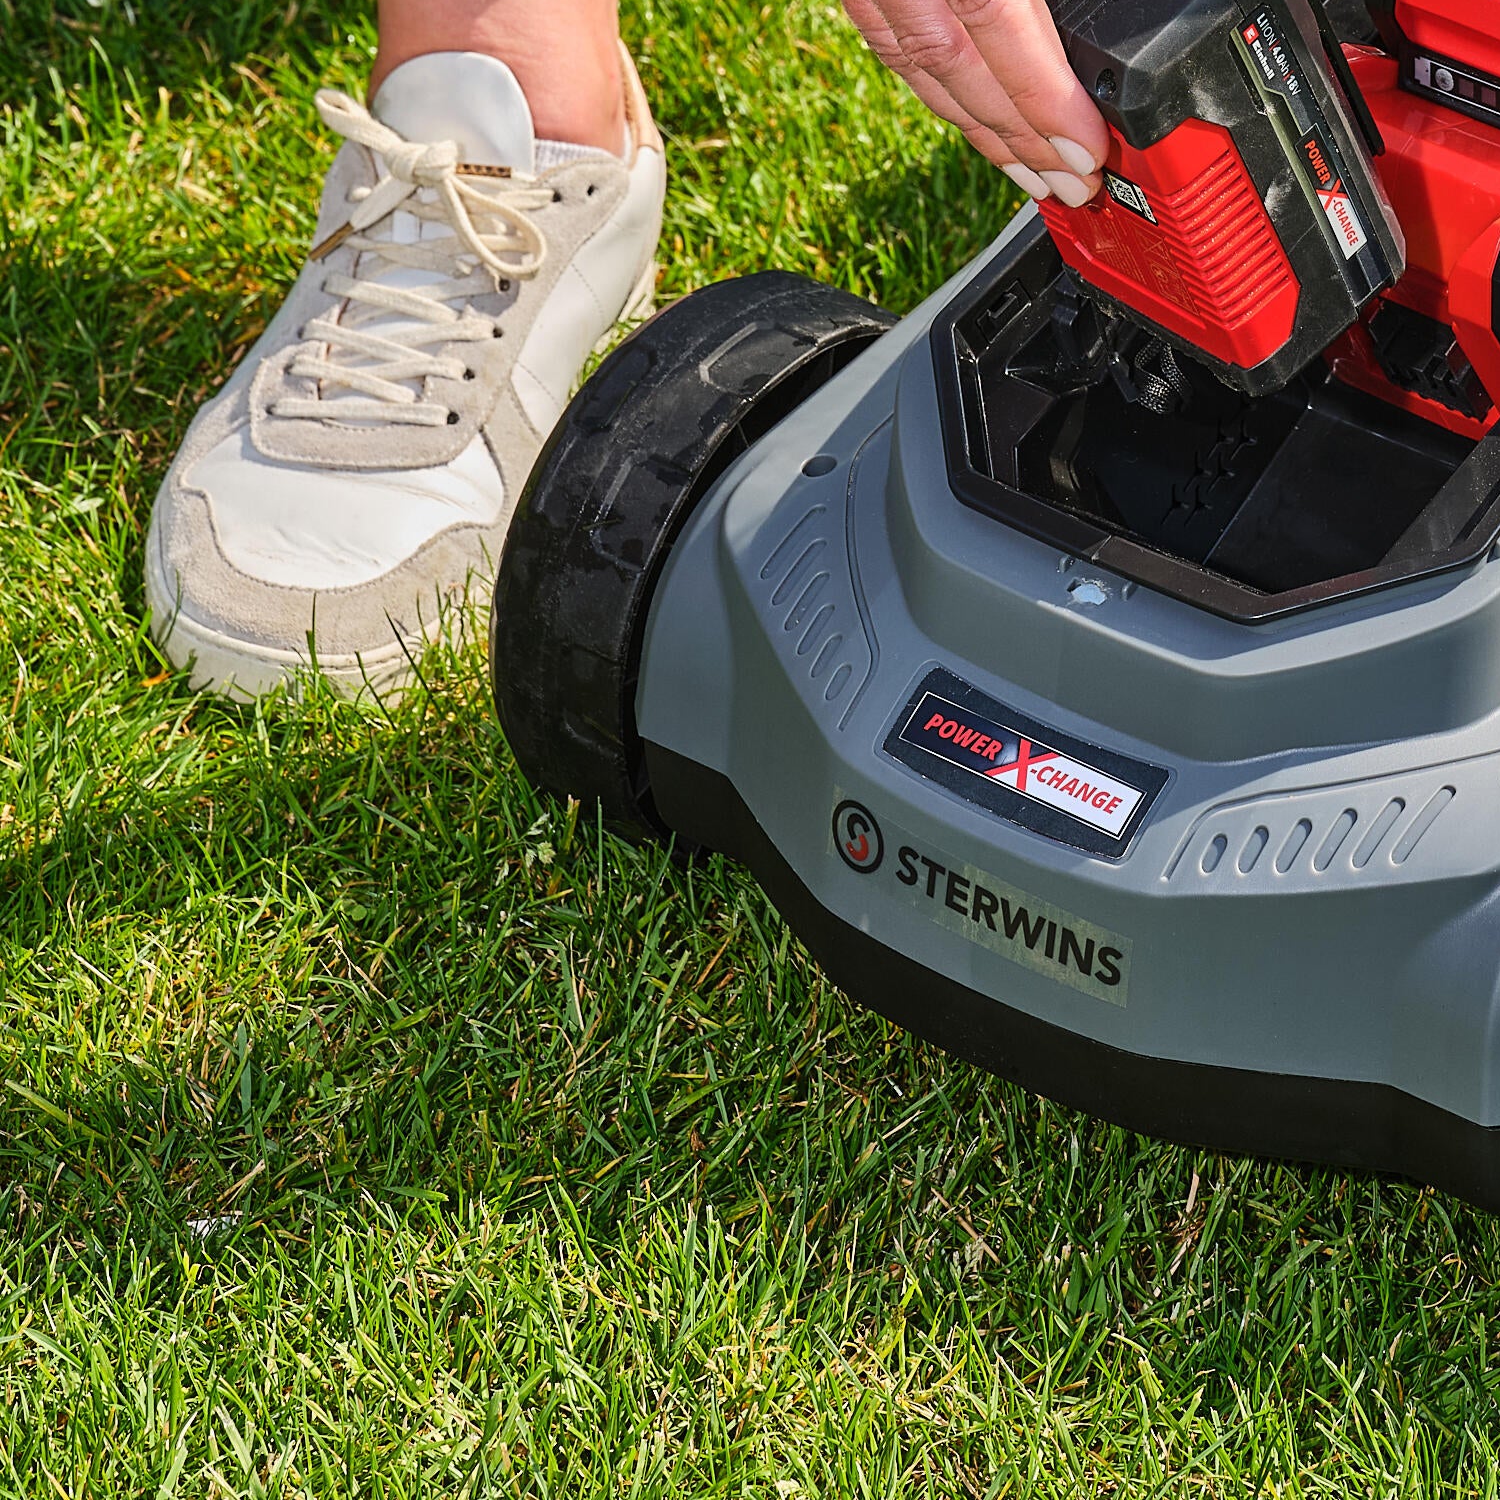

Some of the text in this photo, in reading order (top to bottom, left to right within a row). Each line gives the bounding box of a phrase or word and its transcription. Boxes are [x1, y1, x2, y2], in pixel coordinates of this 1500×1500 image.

[1286, 74, 1301, 96] 18V
[1304, 139, 1331, 185] POWER
[923, 713, 1004, 761] POWER
[895, 845, 1124, 987] STERWINS
